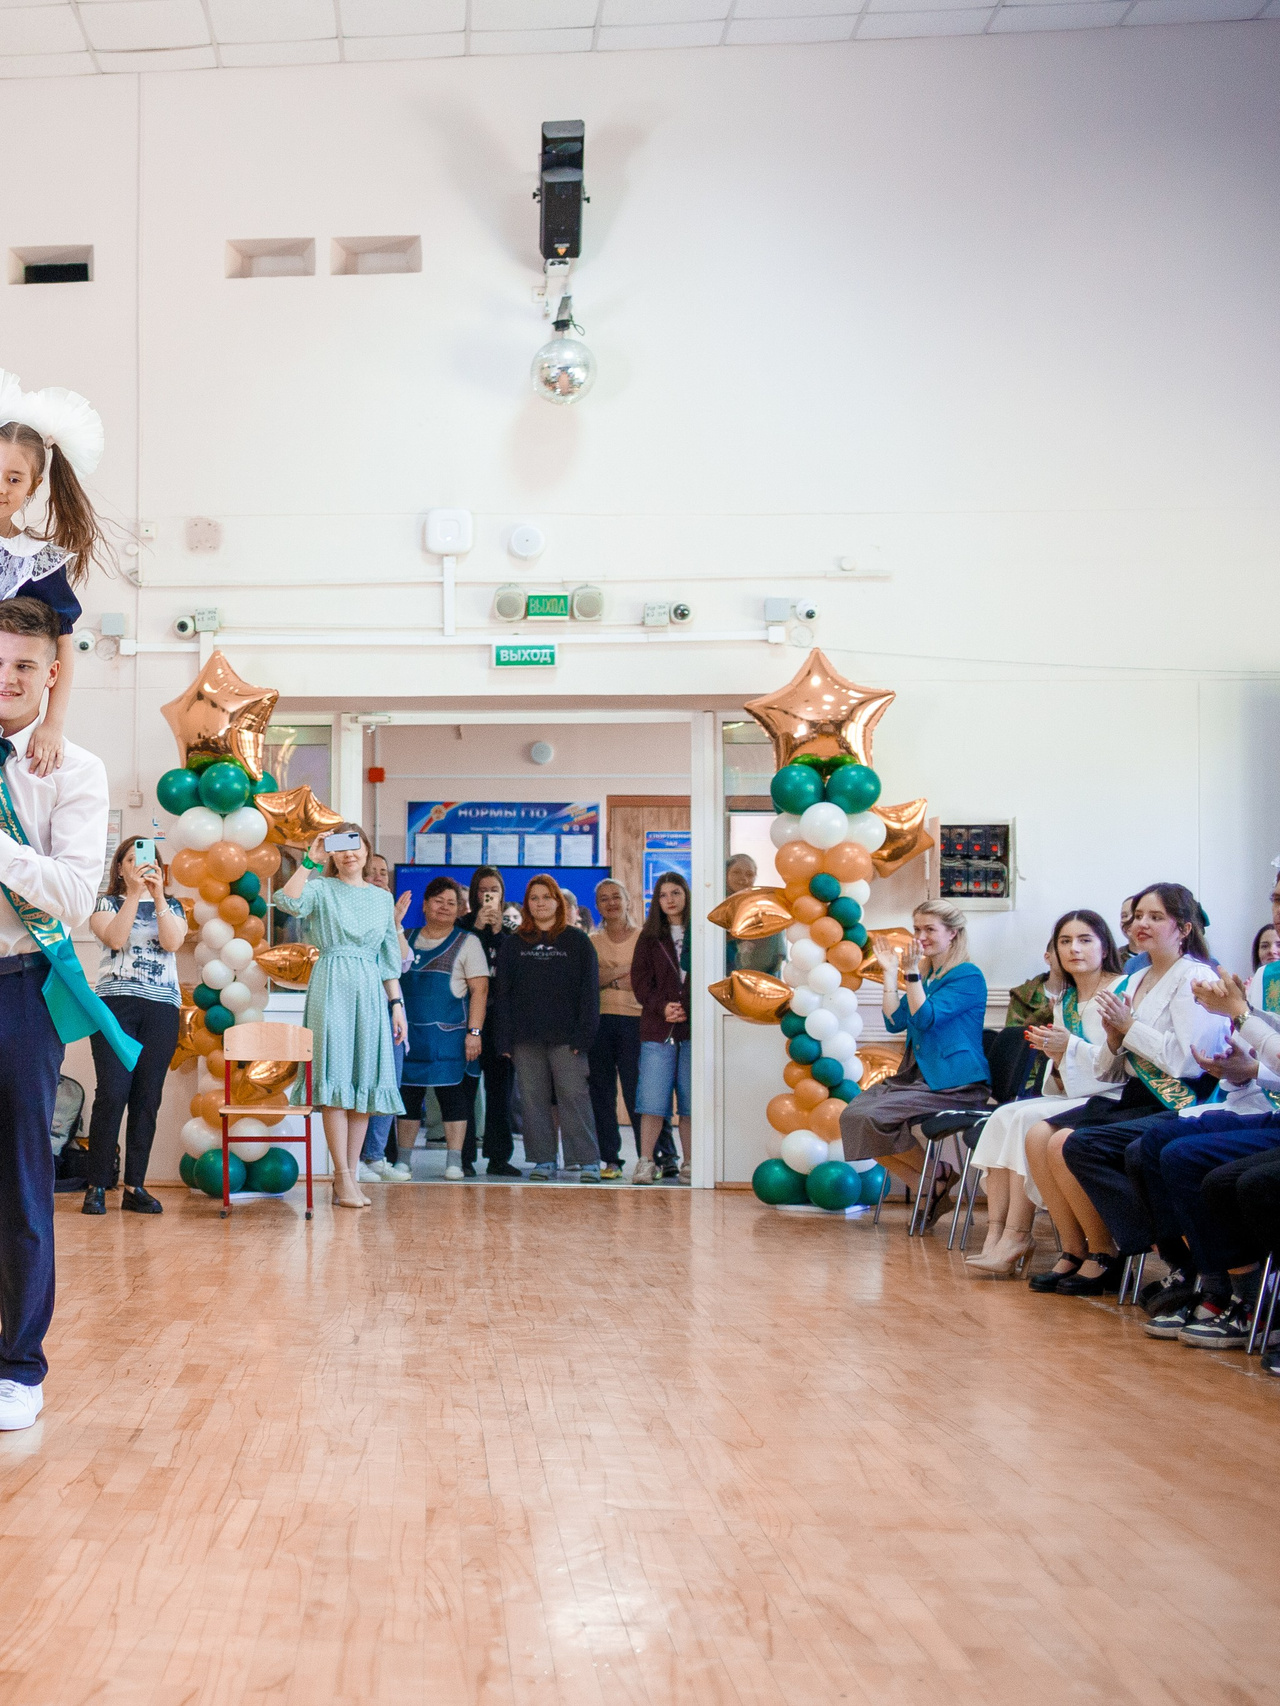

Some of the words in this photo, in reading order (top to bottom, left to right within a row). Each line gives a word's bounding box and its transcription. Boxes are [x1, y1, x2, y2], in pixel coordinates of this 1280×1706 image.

[500, 649, 551, 663] ВЫХОД
[458, 807, 517, 818] НОРМЫ
[520, 807, 548, 818] ГТО
[1148, 1072, 1195, 1109] 2024
